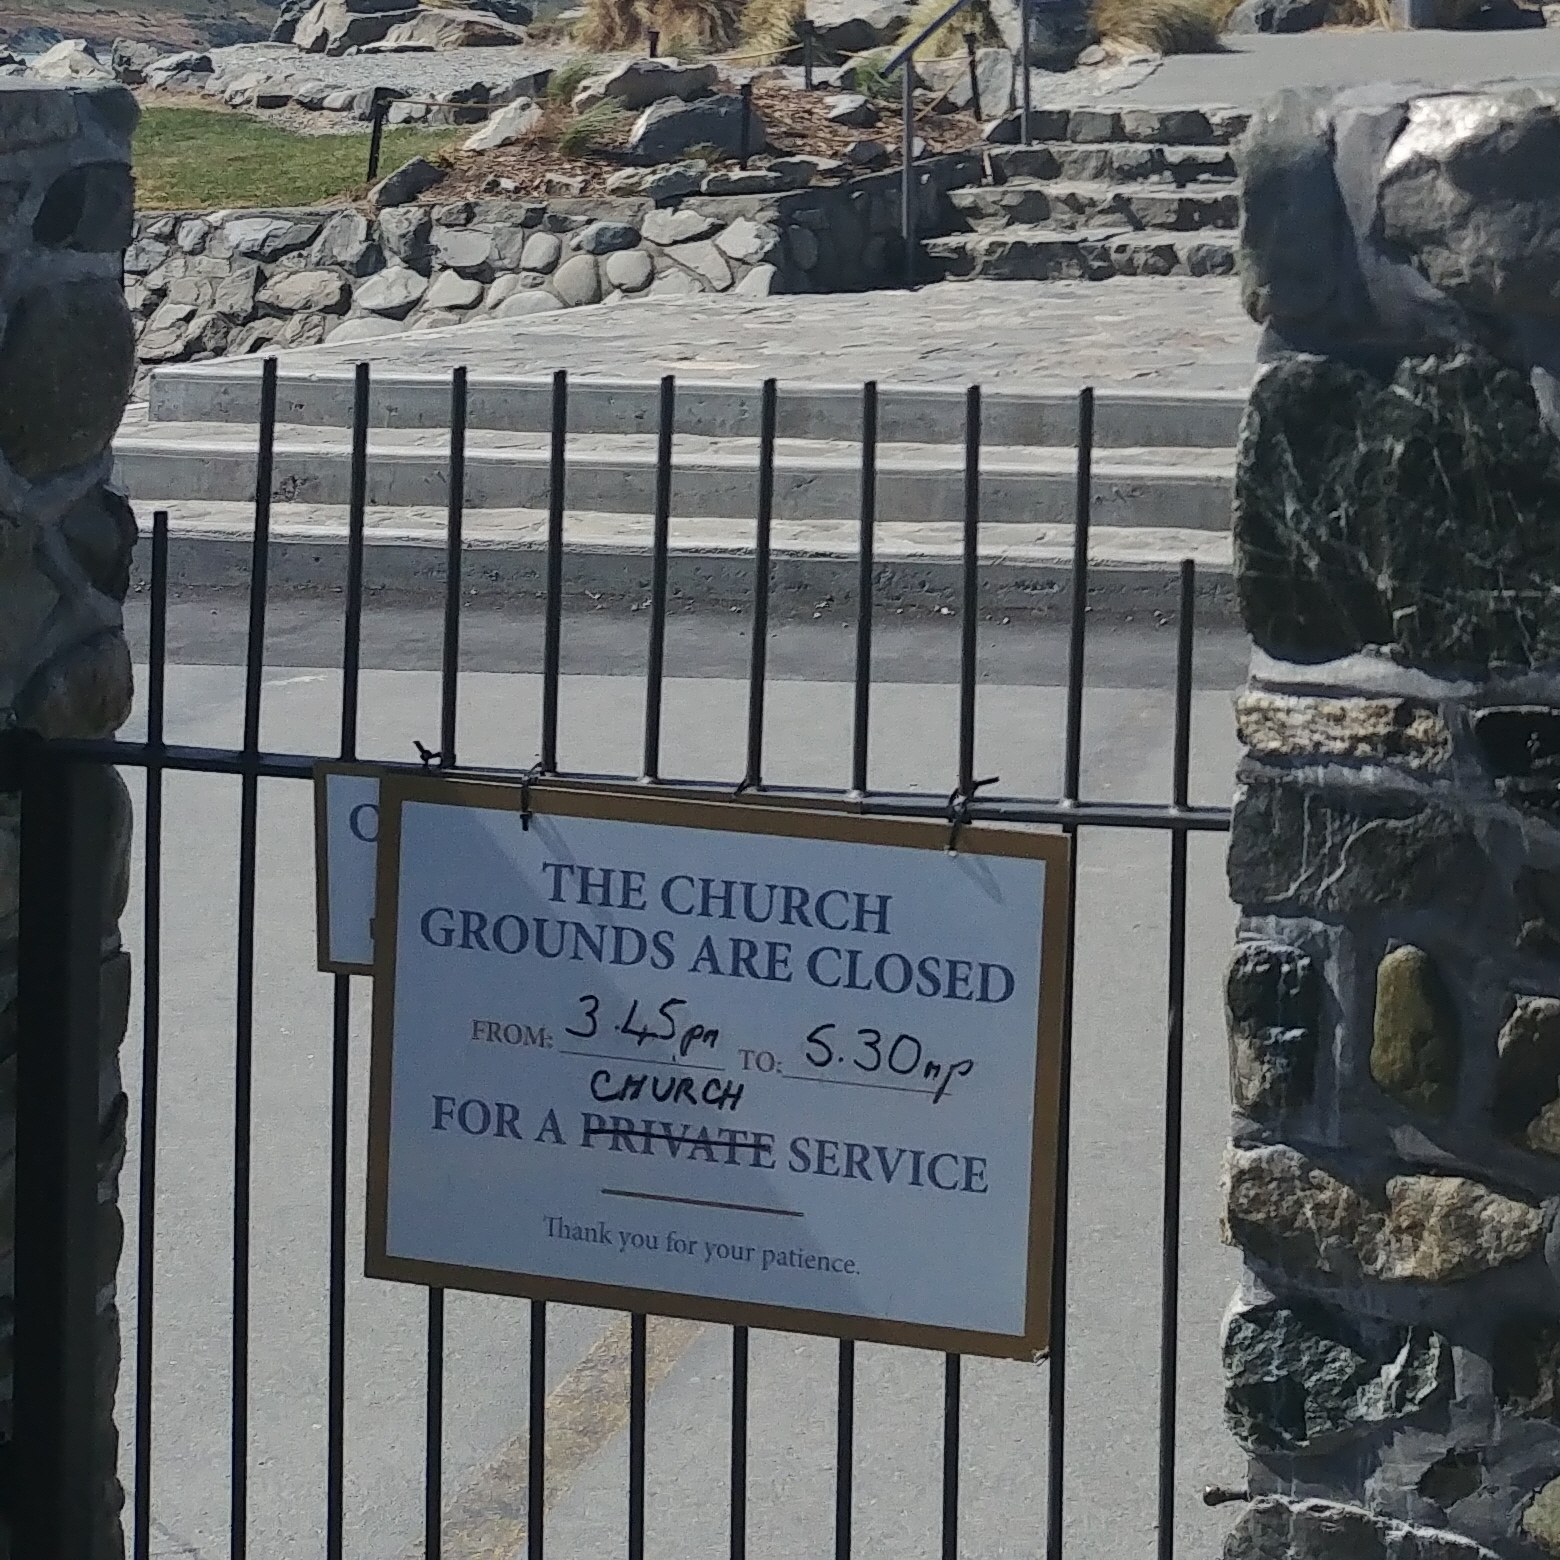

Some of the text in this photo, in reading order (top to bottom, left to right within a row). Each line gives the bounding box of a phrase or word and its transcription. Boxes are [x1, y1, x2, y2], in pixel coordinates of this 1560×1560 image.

[543, 861, 893, 935] THE CHURCH
[420, 907, 1015, 1003] GROUNDS ARE CLOSED
[471, 1019, 553, 1049] FROM:
[739, 1049, 784, 1074] TO:
[591, 1069, 744, 1111] CHURCH
[432, 1094, 989, 1193] FOR A PRIVATE SERVICE
[543, 1214, 861, 1276] Thank you for your patience.
